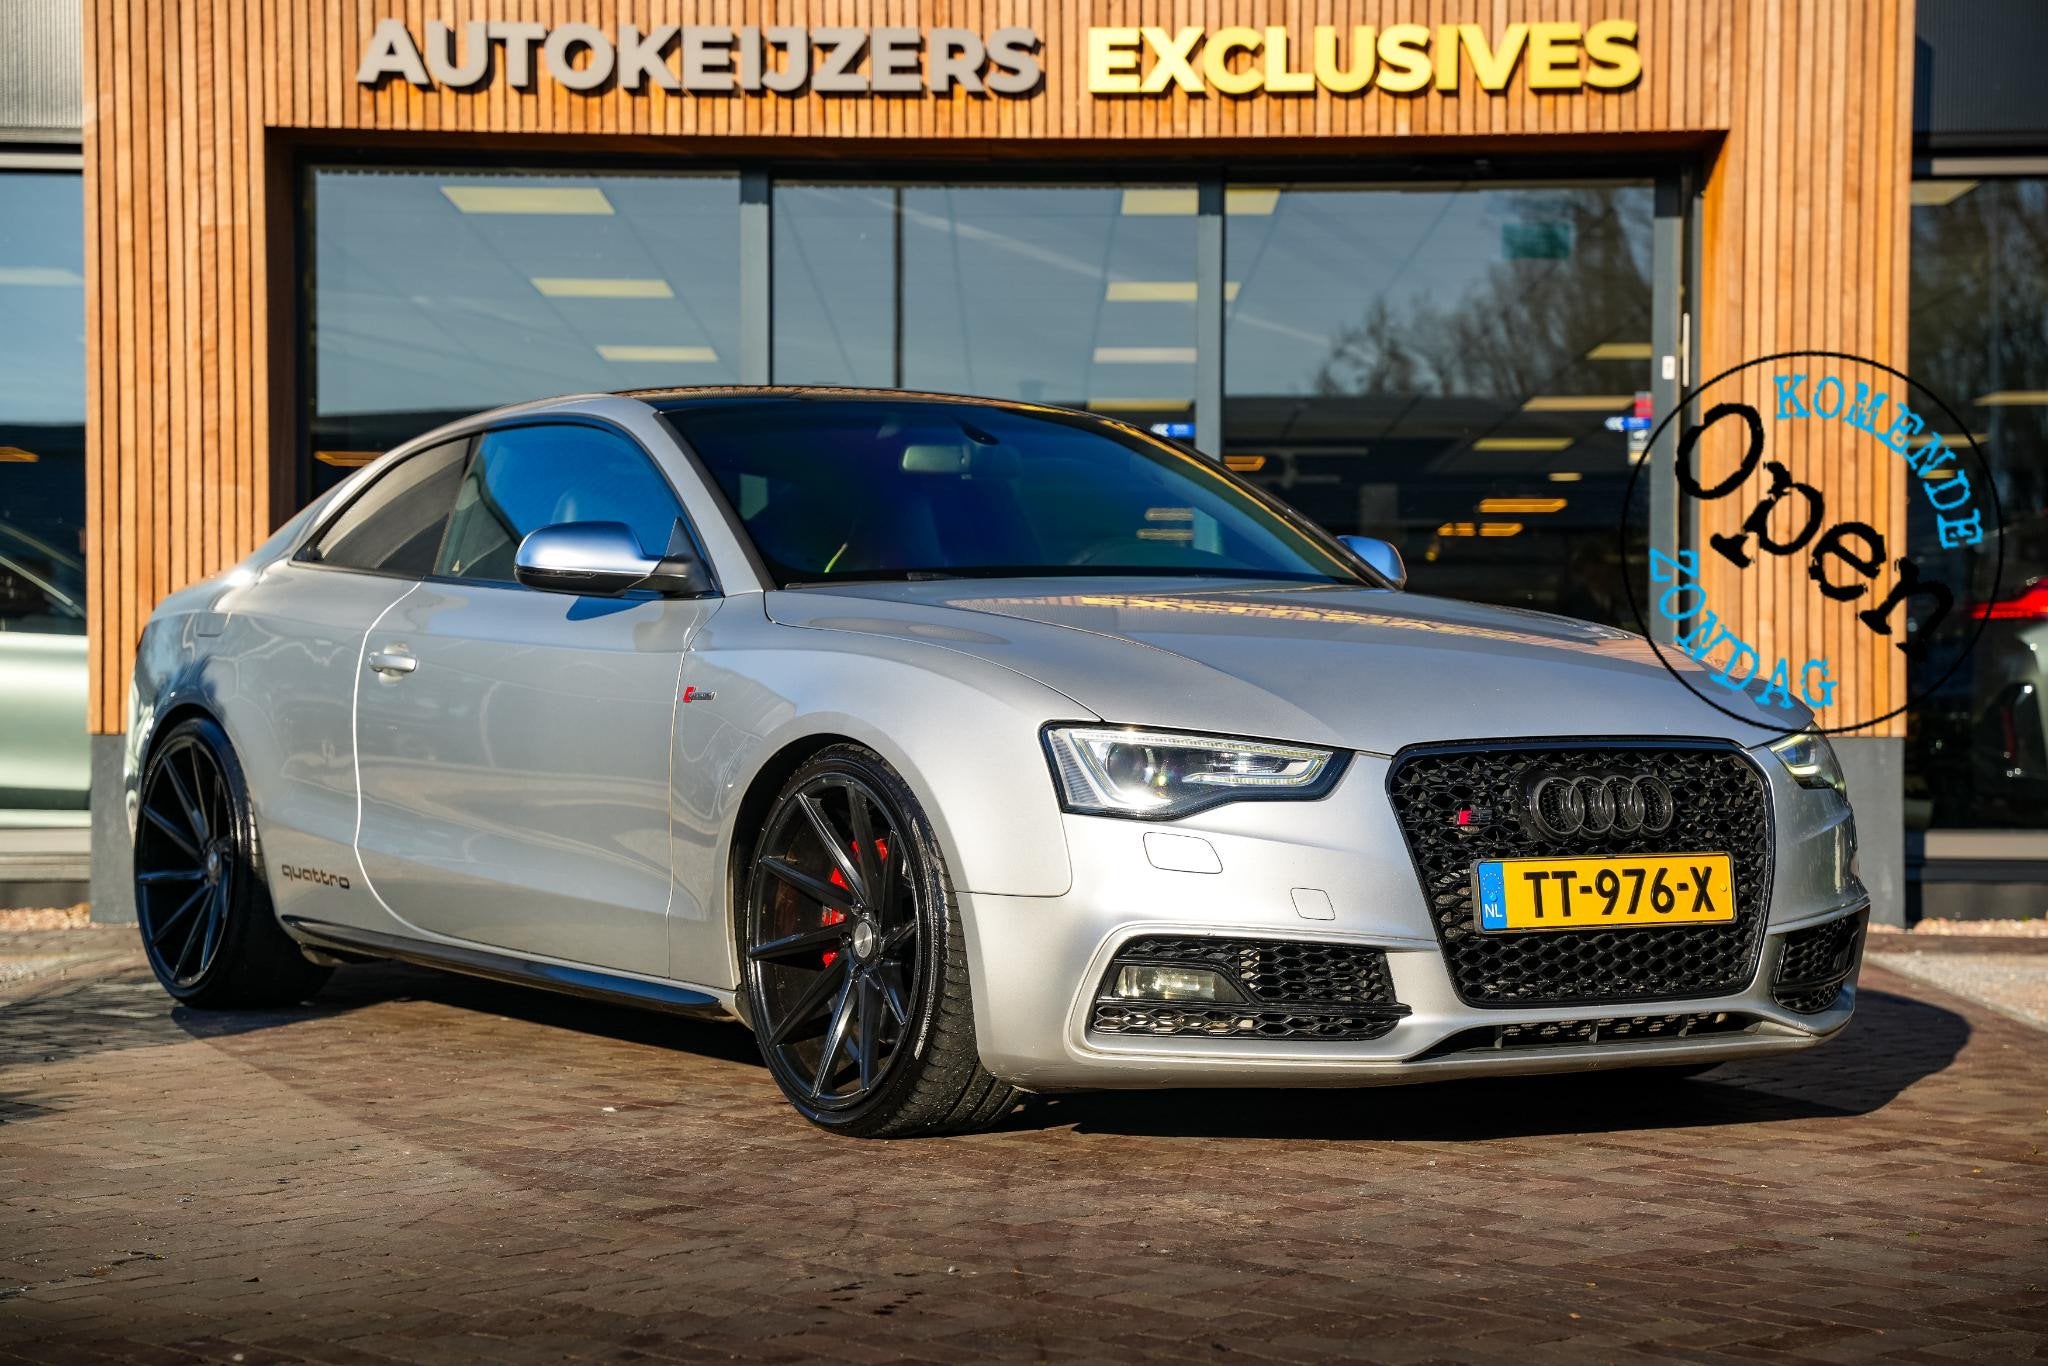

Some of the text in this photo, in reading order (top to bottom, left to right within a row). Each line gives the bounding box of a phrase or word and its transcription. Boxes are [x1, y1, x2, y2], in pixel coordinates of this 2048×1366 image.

[357, 19, 1642, 94] AUTOKEIJZERS EXCLUSIVES
[281, 864, 350, 890] quattro
[1523, 866, 1716, 918] TT-976-X
[1484, 903, 1503, 918] NL
